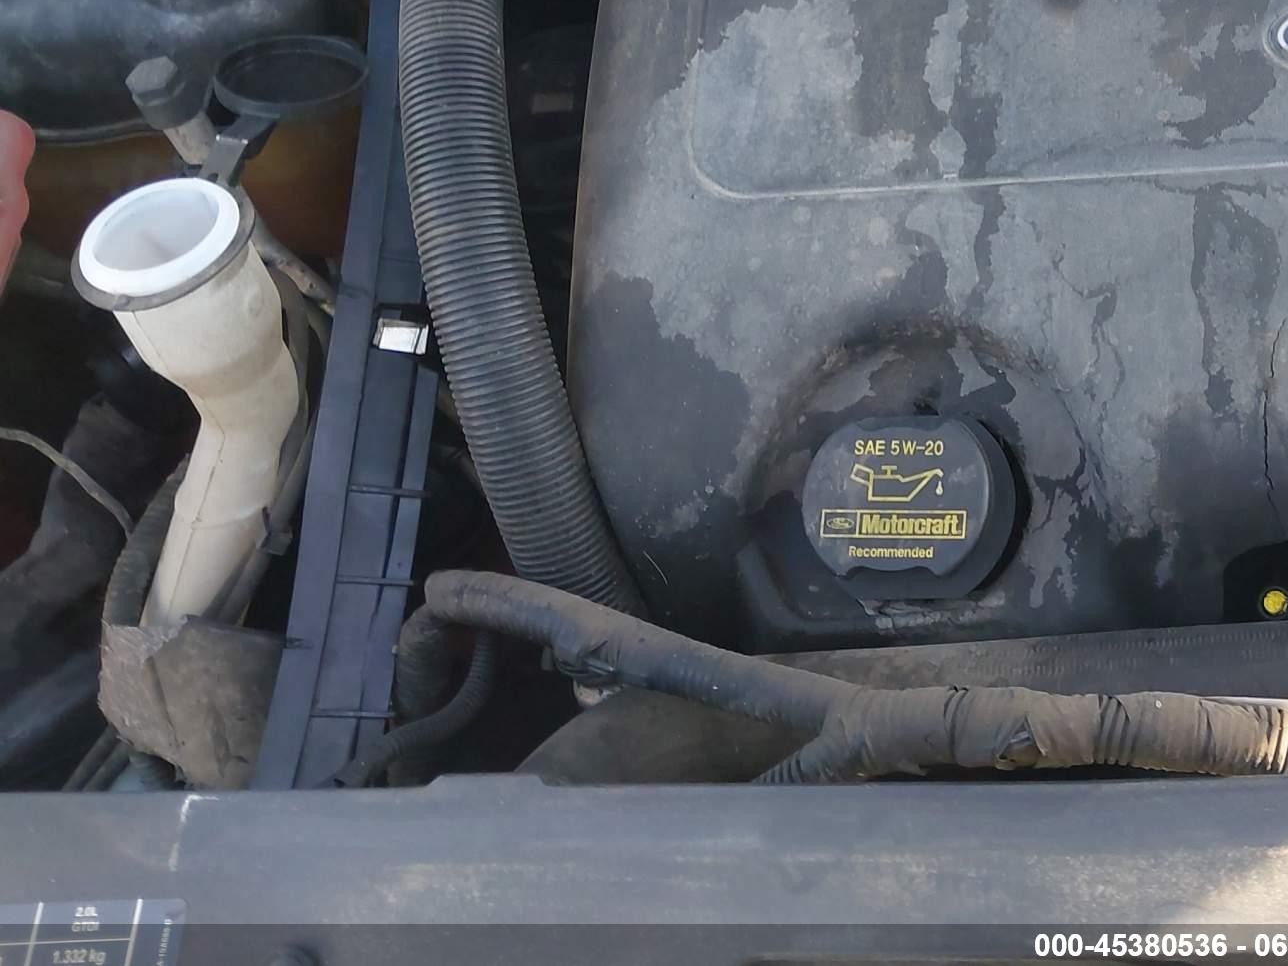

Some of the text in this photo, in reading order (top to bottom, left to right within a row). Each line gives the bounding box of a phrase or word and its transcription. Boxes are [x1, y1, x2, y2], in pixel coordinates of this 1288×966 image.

[854, 439, 944, 456] SAE 5W-20
[861, 514, 959, 535] Motorcraft
[848, 545, 934, 558] Recommended
[52, 948, 107, 966] 1.332 kg
